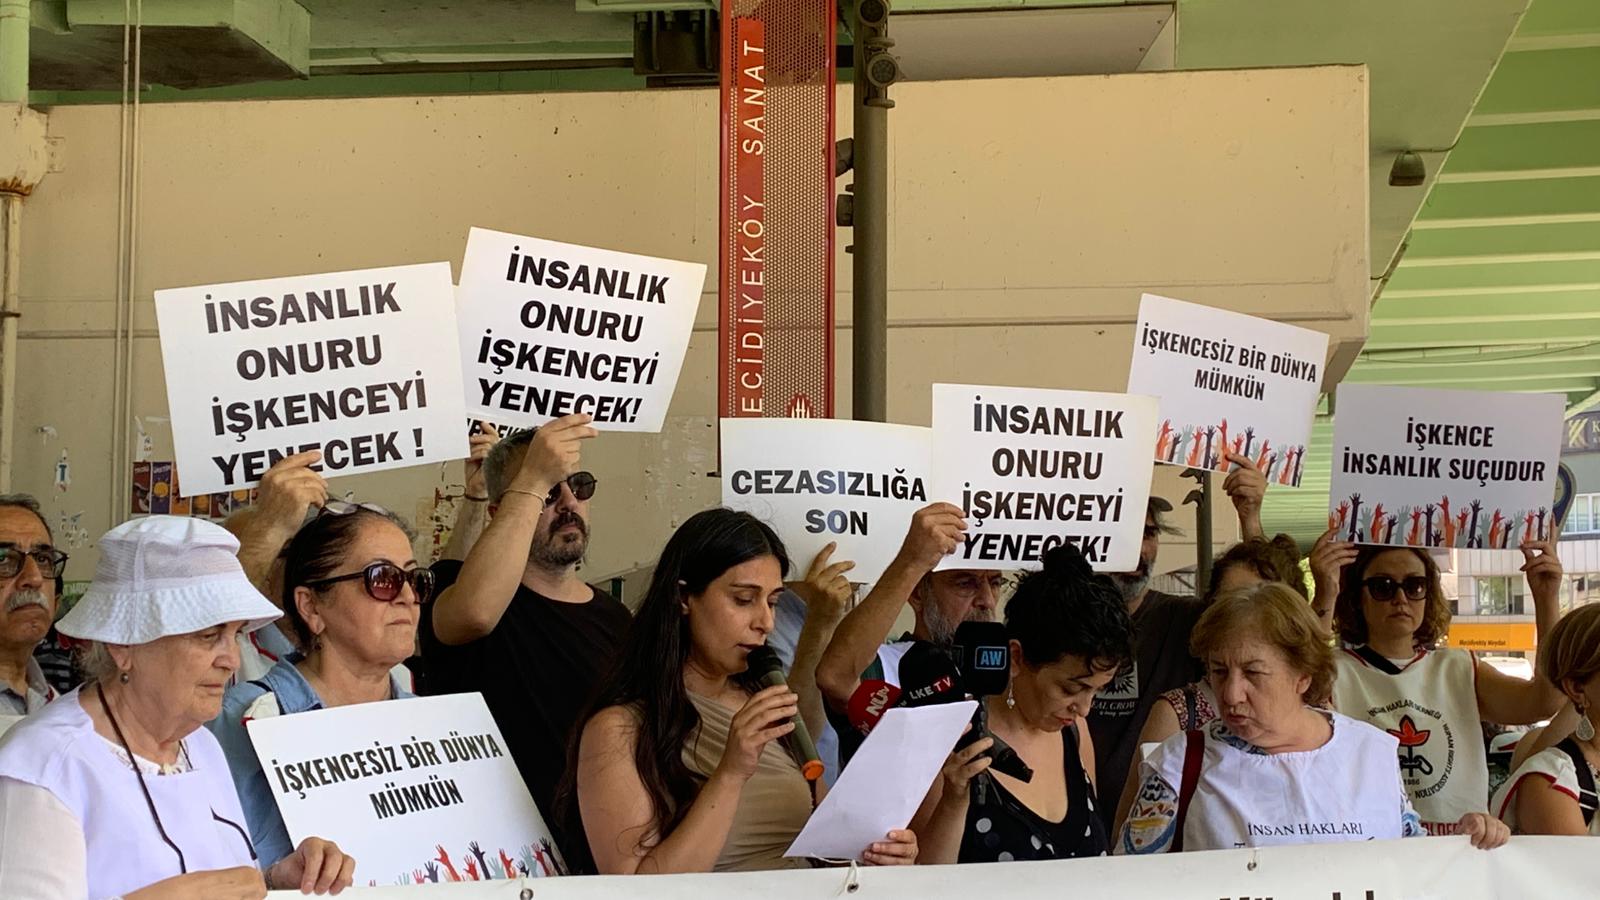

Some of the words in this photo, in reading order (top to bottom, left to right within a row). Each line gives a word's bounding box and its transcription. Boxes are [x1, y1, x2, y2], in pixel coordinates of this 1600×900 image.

[742, 40, 764, 155] SANAT
[506, 245, 670, 304] İNSANLIK
[204, 282, 402, 334] İNSANLIK
[520, 300, 644, 342] ONURU
[737, 193, 764, 413] ECİDİYEKÖY
[236, 334, 383, 380] ONURU
[477, 328, 660, 385] İŞKENCEYİ
[1141, 322, 1235, 364] İŞKENCESİZ
[1238, 345, 1266, 371] BİR
[1270, 352, 1317, 383] DÜNYA
[211, 370, 427, 442] İŞKENCEYİ
[1194, 367, 1266, 401] MÜMKÜN
[973, 395, 1124, 439] İNSANLIK
[1406, 417, 1495, 451] İŞKENCE
[731, 468, 927, 501] CEZASIZLIĞA
[991, 447, 1103, 480] ONURU
[1343, 447, 1442, 479] İNSANLIK
[1448, 457, 1546, 487] SUÇUDUR
[805, 508, 868, 535] SON
[962, 482, 1123, 527] İŞKENCEYİ
[980, 651, 1002, 666] AW
[908, 685, 934, 701] LKE
[933, 676, 953, 692] TV
[272, 740, 402, 799] İŞKENCESİZ
[400, 735, 441, 769] BİR
[439, 731, 503, 763] DÜNYA
[369, 775, 464, 820] MÜMKÜN
[1248, 821, 1294, 836] İNSAN
[1299, 821, 1363, 836] HAKLARI
